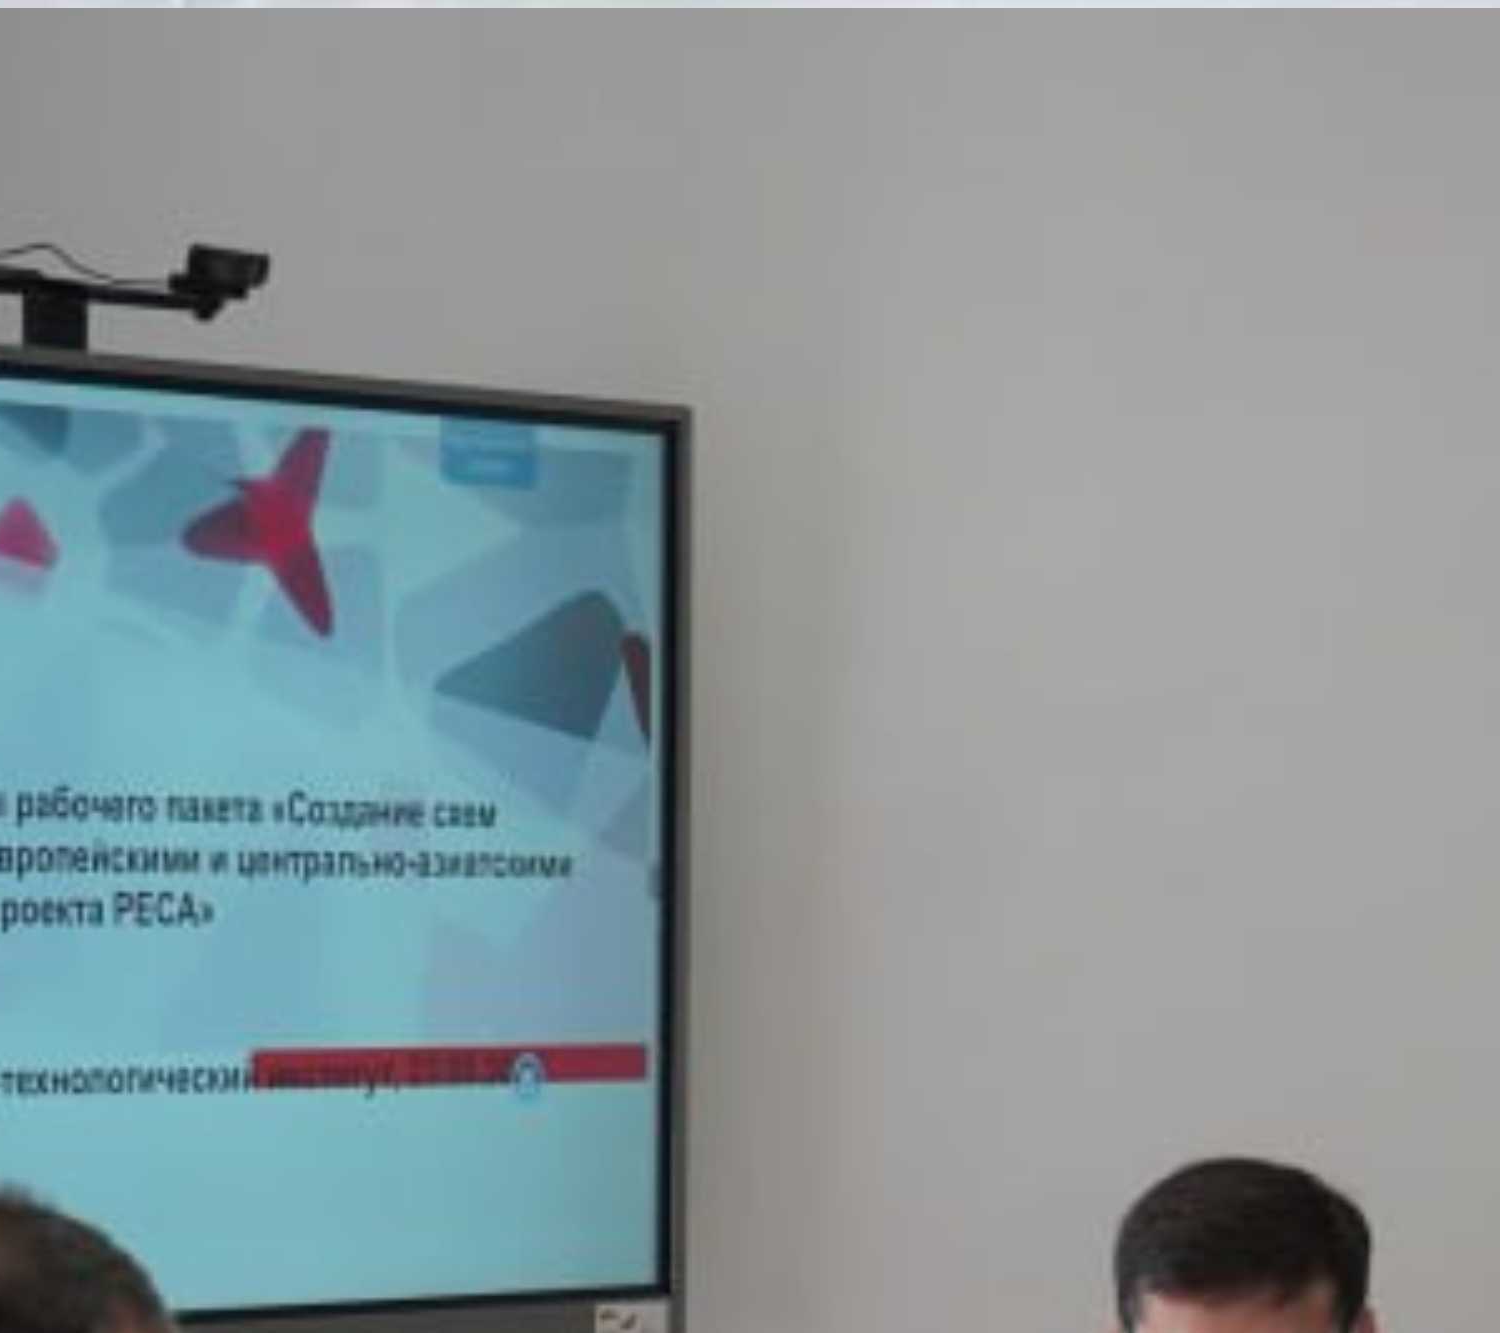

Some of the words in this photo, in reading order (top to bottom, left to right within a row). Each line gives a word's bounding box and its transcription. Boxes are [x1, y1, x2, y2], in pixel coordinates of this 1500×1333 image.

[16, 786, 157, 827] рабочего
[166, 795, 264, 824] пакета
[209, 849, 229, 873] и
[237, 849, 574, 883] центрально-азиатскими
